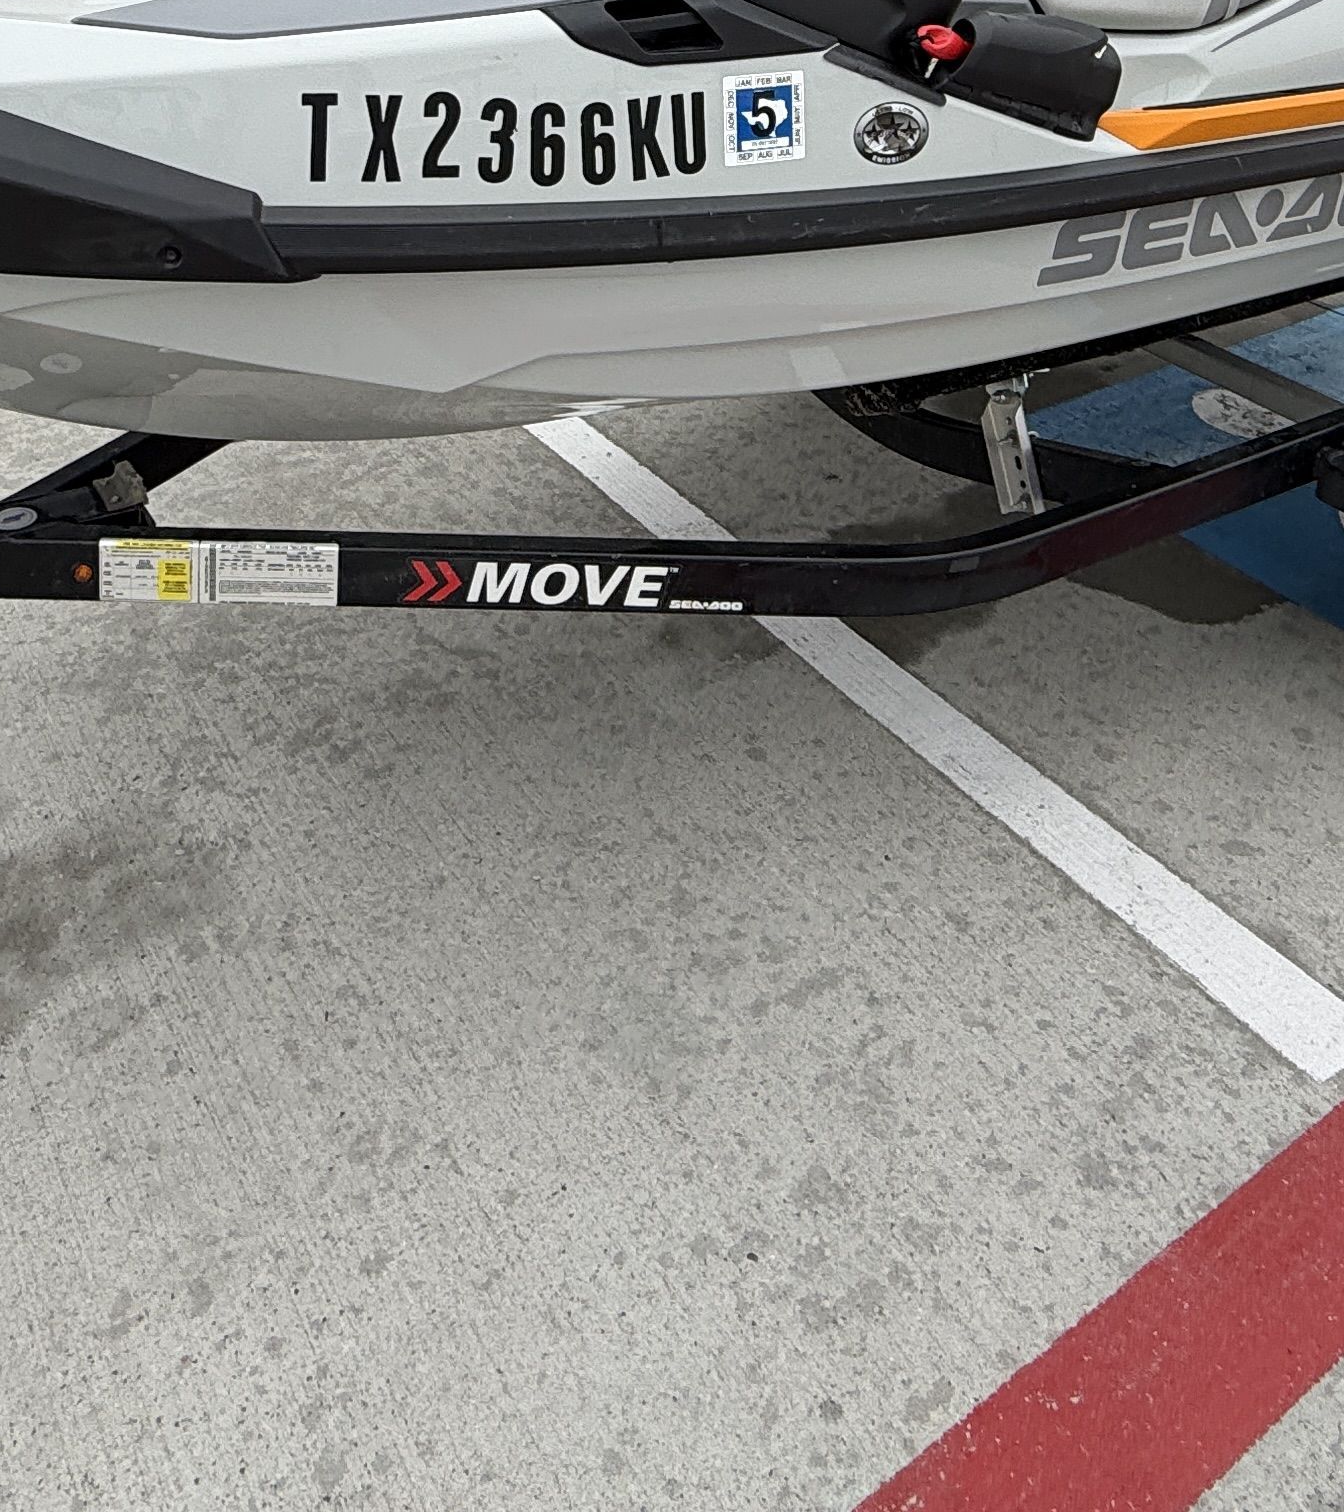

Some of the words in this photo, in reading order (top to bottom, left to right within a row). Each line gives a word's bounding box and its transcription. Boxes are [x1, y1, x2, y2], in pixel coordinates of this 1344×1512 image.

[736, 79, 752, 87] JAN
[756, 77, 772, 85] FEB
[751, 89, 776, 138] 5
[466, 561, 669, 608] MOVE
